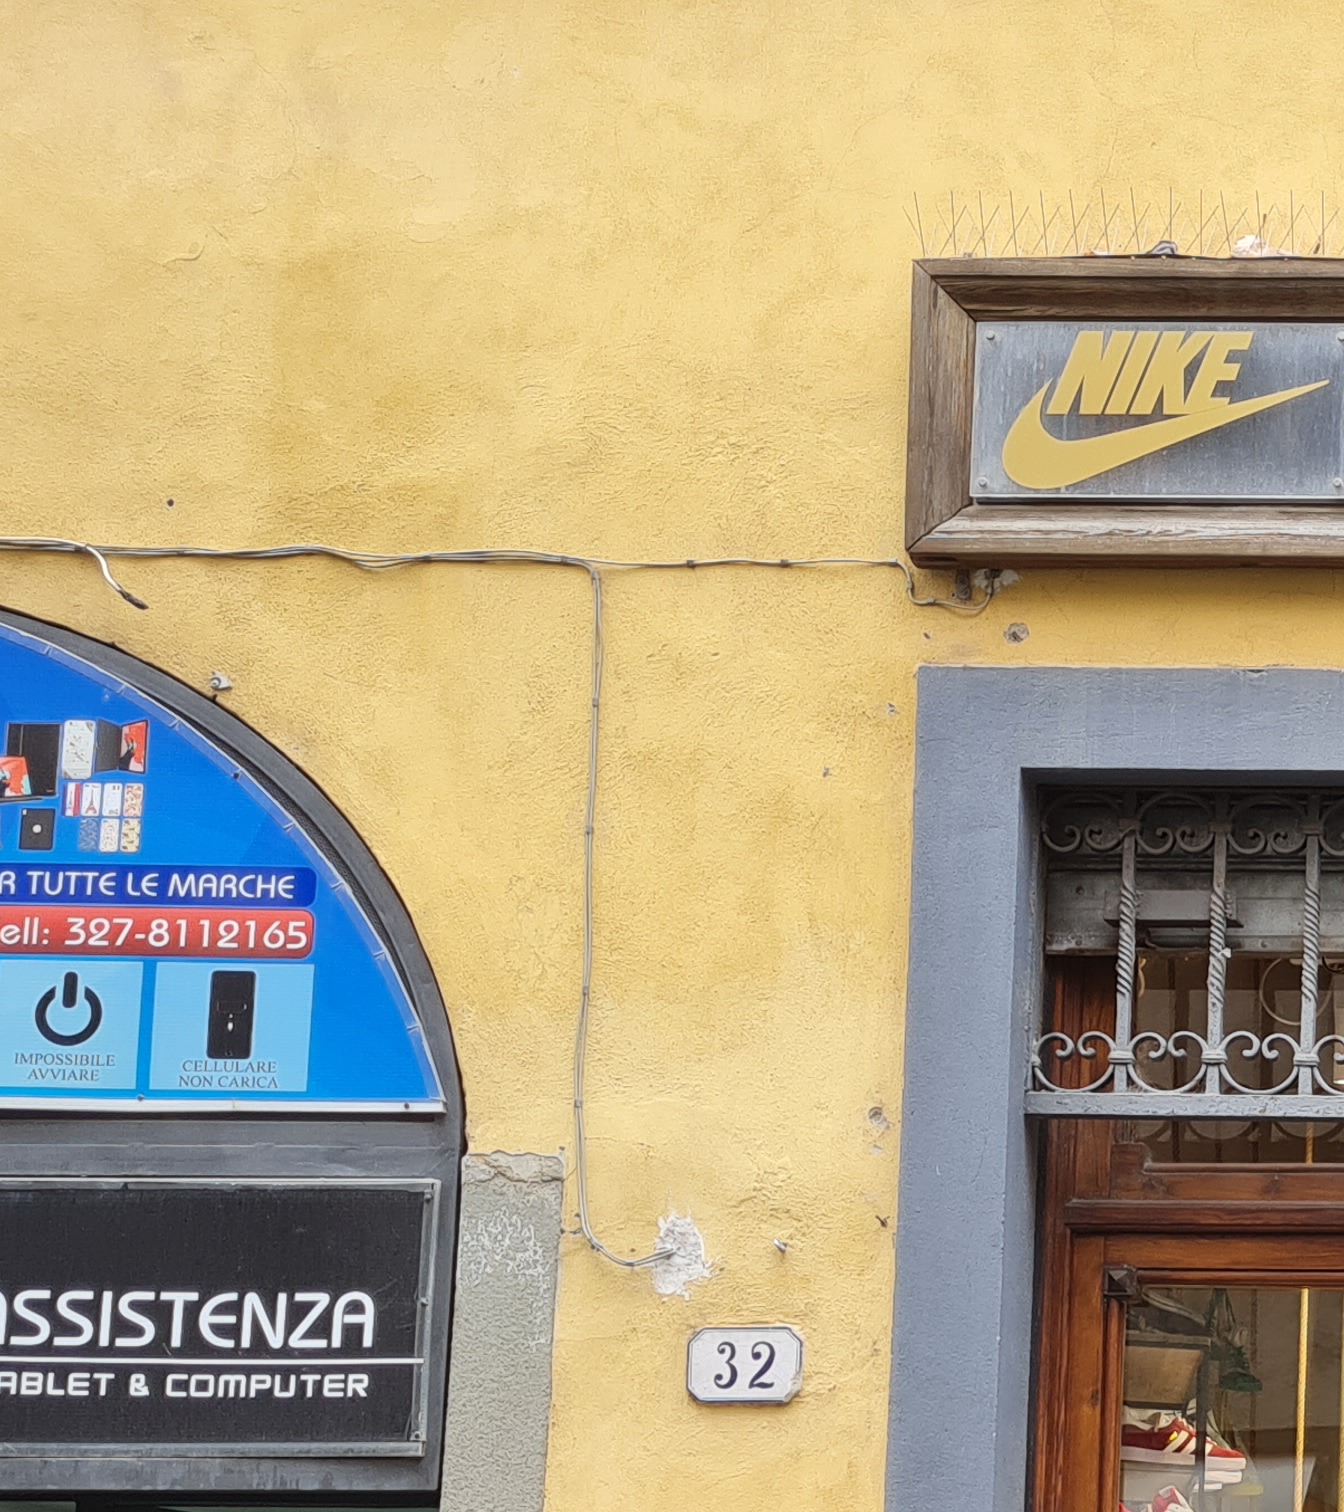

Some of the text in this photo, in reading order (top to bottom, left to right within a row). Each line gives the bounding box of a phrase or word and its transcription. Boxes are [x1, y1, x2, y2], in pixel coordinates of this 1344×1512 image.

[1045, 330, 1254, 416] NIKE
[27, 871, 117, 896] TUTTE
[127, 872, 159, 897] LE
[168, 873, 295, 899] MARCHE
[64, 917, 308, 949] 327-8112165
[14, 1053, 116, 1066] IMPOSSIBILE
[182, 1060, 277, 1073] CELLULARE
[27, 1068, 100, 1082] AVVIARE
[178, 1075, 279, 1089] NON CARICA
[713, 1341, 776, 1390] 32
[129, 1372, 150, 1396] &
[165, 1373, 370, 1398] COMPUTER
